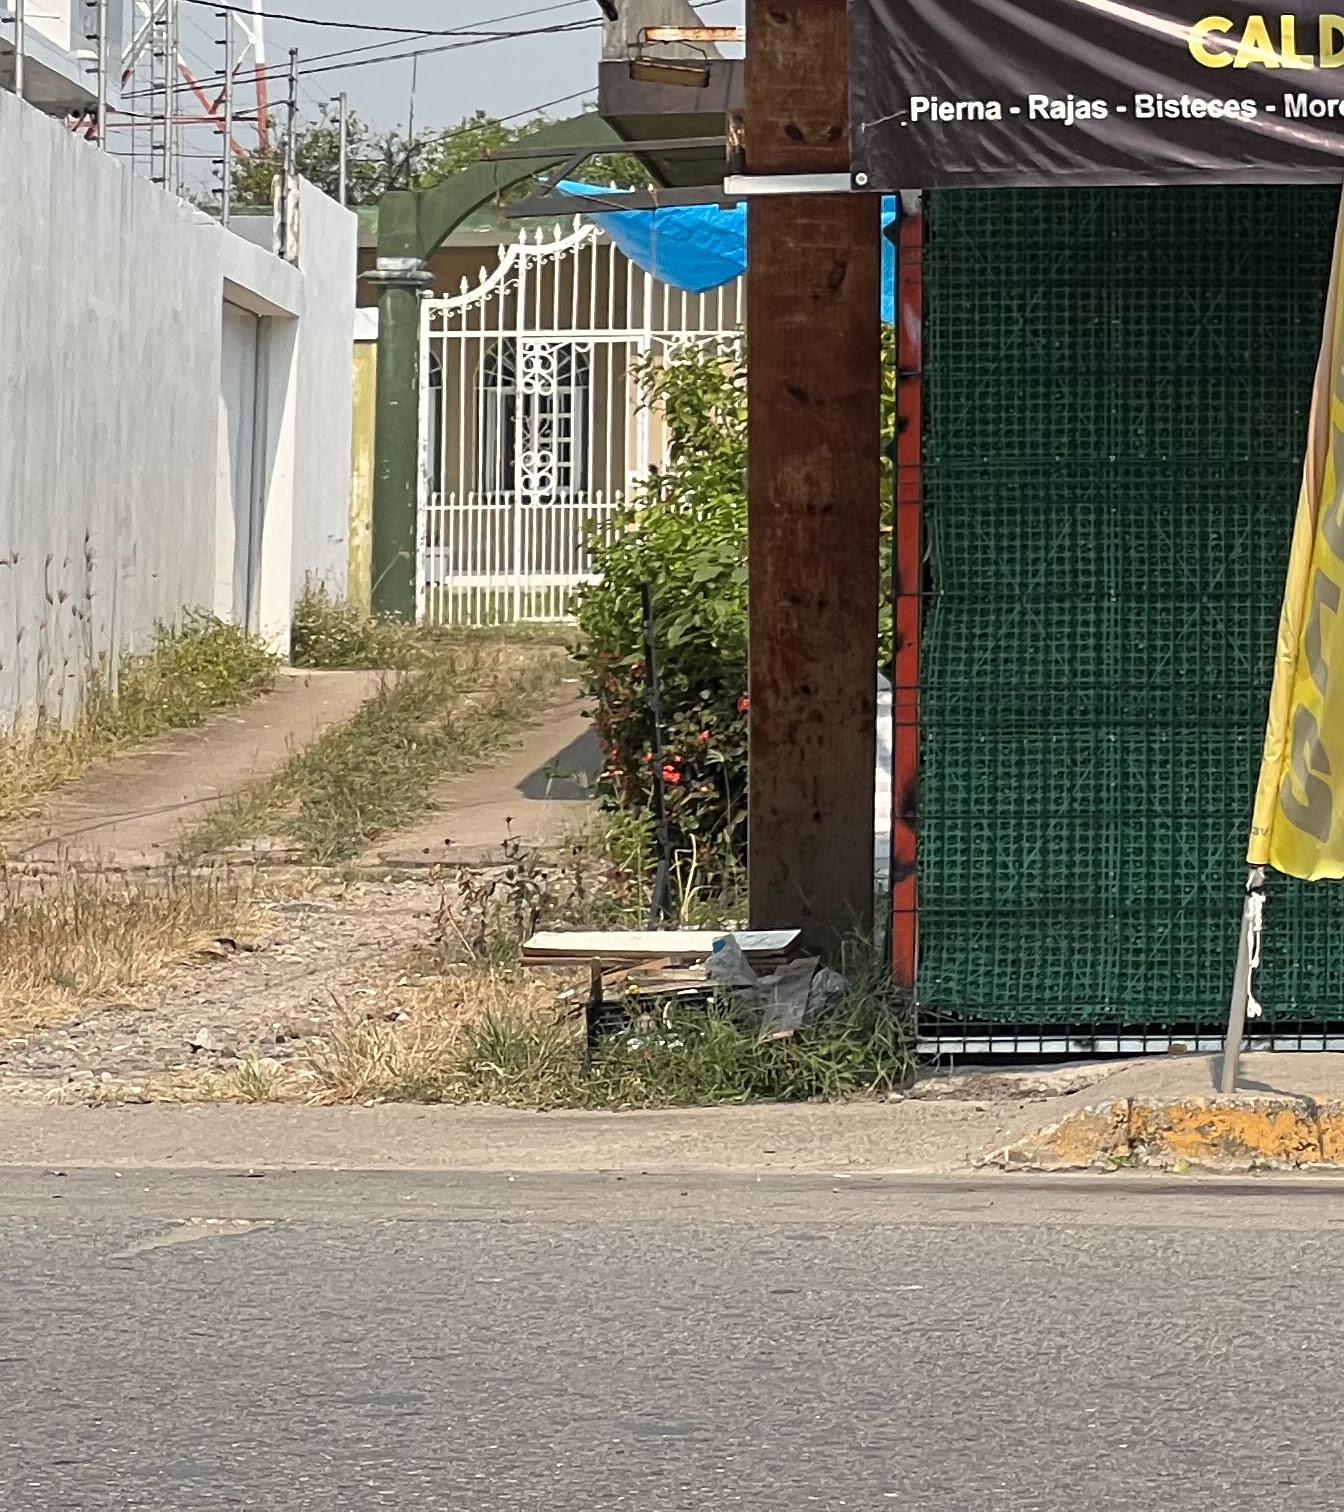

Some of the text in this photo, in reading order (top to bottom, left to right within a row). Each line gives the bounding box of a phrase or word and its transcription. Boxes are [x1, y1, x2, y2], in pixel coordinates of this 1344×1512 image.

[911, 95, 1001, 122] Pierna
[1028, 94, 1108, 127] Rajas
[1135, 92, 1256, 119] Bisteces
